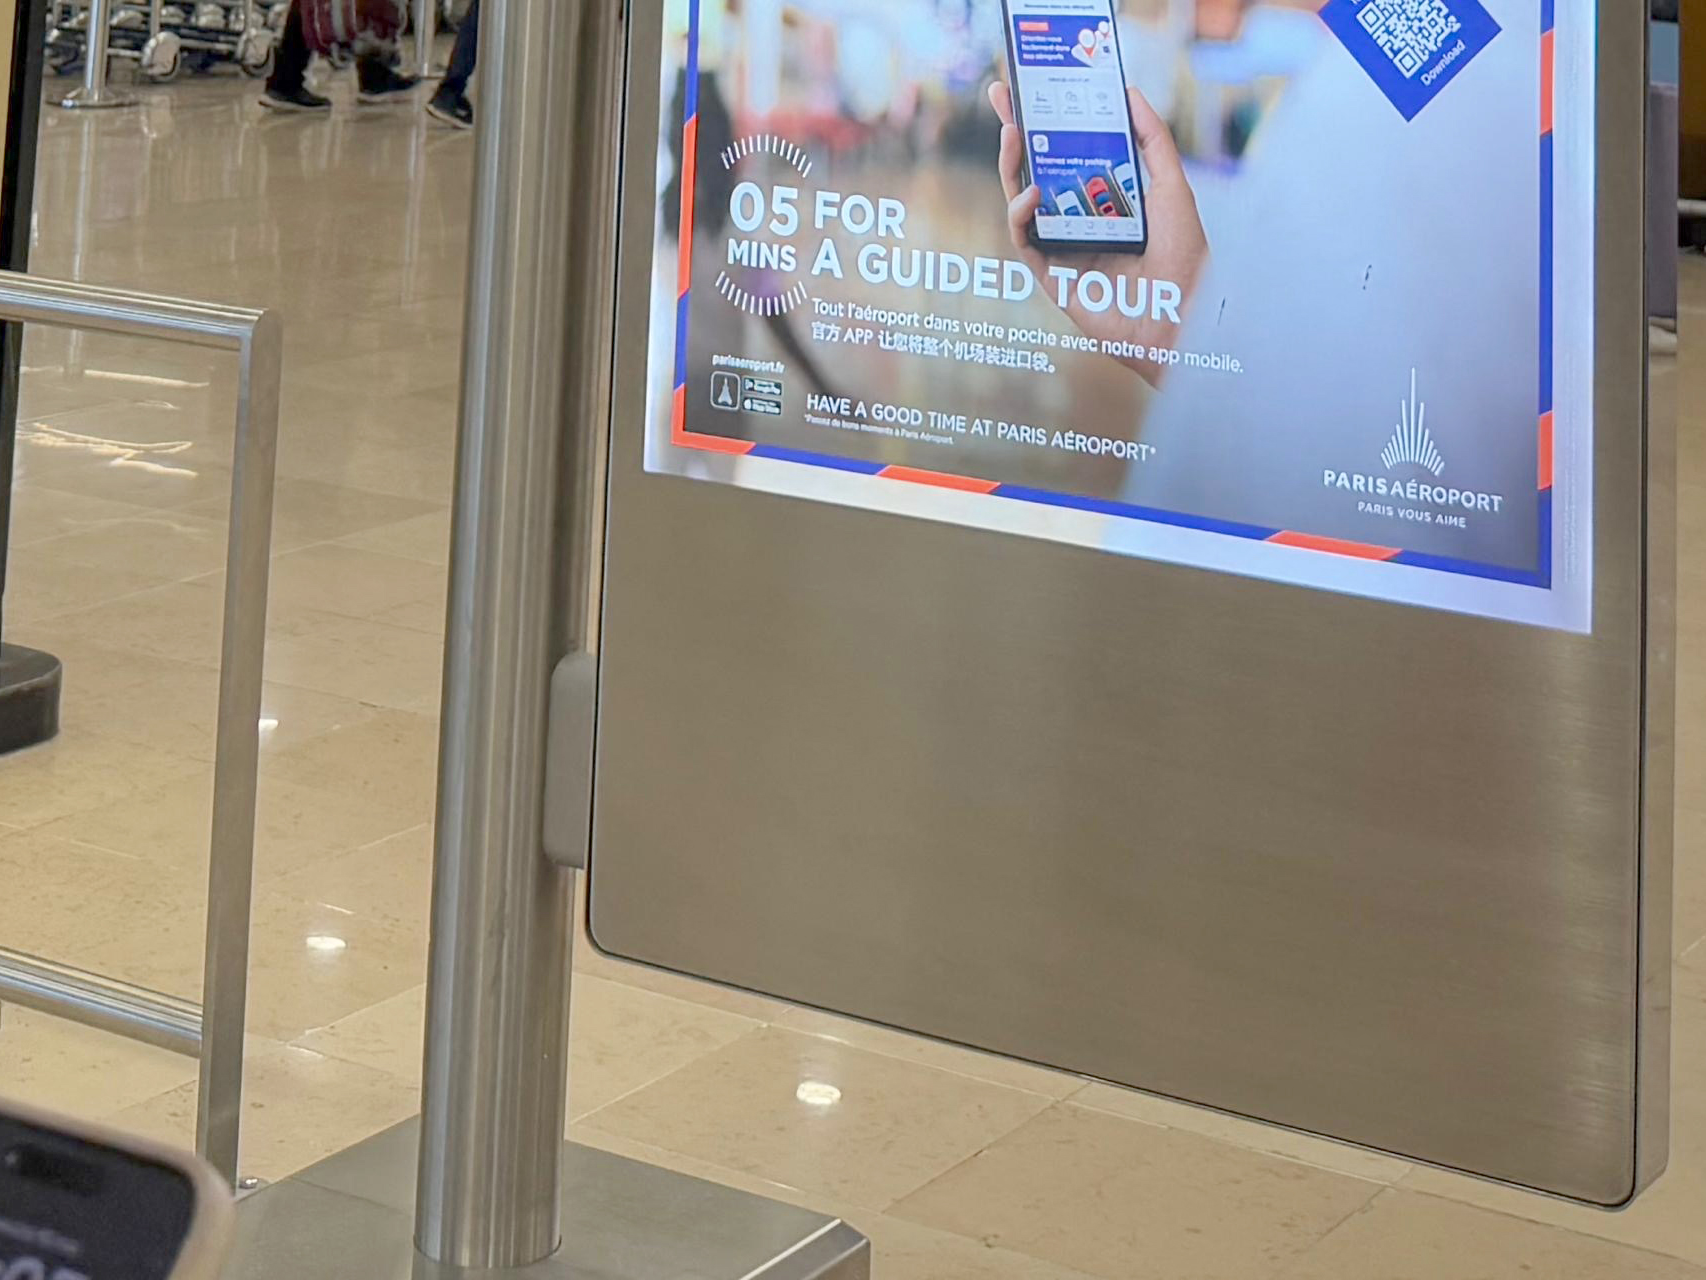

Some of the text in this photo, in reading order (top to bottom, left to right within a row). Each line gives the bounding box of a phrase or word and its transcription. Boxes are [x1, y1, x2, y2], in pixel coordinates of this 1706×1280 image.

[1420, 39, 1466, 87] Download
[729, 181, 906, 239] 05 FOR
[727, 238, 1182, 324] MINS A GUIDED TOUR
[811, 320, 840, 341] 官方
[843, 326, 874, 346] APP
[812, 297, 1244, 373] Tout l'aéroport dans votre poche avec notre app mobile.
[806, 393, 851, 417] HAVE
[854, 400, 867, 419] A
[871, 403, 923, 426] GOOD
[928, 411, 966, 433] TIME
[970, 417, 993, 437] AT
[997, 421, 1047, 446] PARIS
[1357, 501, 1468, 529] PARIS VOUS AIME
